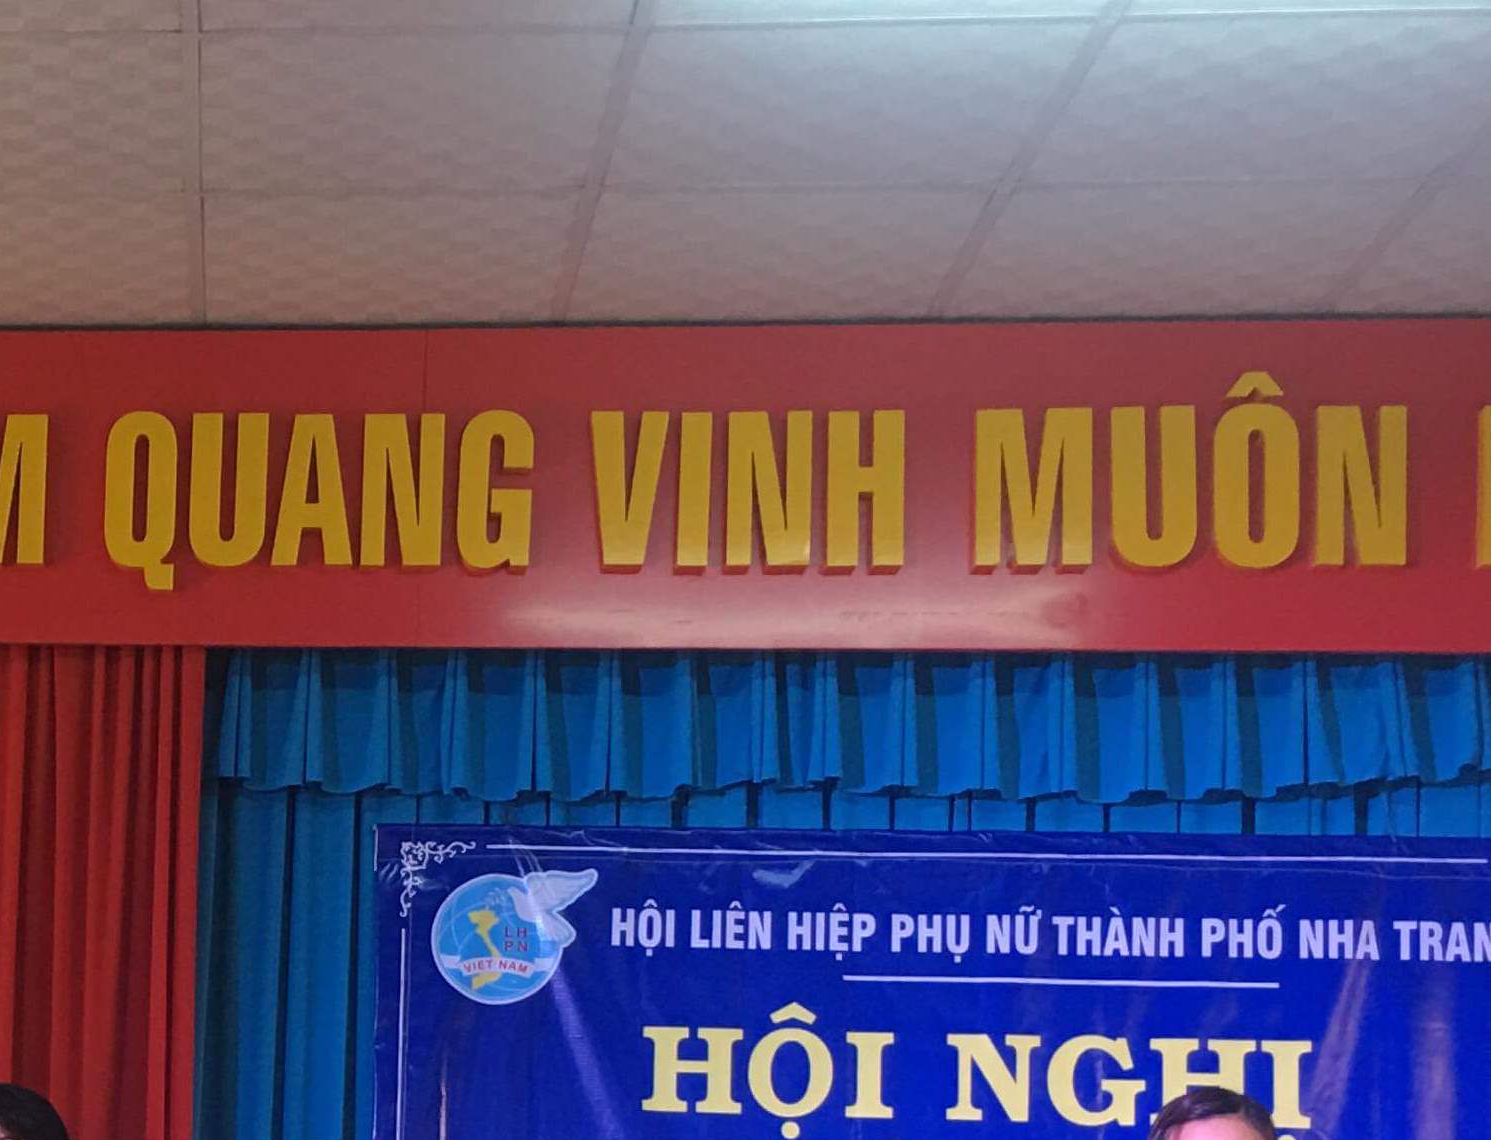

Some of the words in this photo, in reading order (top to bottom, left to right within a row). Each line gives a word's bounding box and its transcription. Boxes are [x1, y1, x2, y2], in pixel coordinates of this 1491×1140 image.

[103, 410, 535, 591] QUANG
[590, 409, 905, 574] VINH
[970, 371, 1407, 574] MUÔN
[611, 899, 675, 957] HỘI
[690, 900, 772, 950] LIÊN
[787, 902, 877, 961] HIỆP
[890, 912, 970, 963] PHỤ
[986, 905, 1042, 955] NỮ
[1052, 906, 1184, 957] THÀNH
[1201, 903, 1286, 959] PHỐ
[1299, 919, 1380, 961] NHA
[641, 1001, 895, 1140] HỘI
